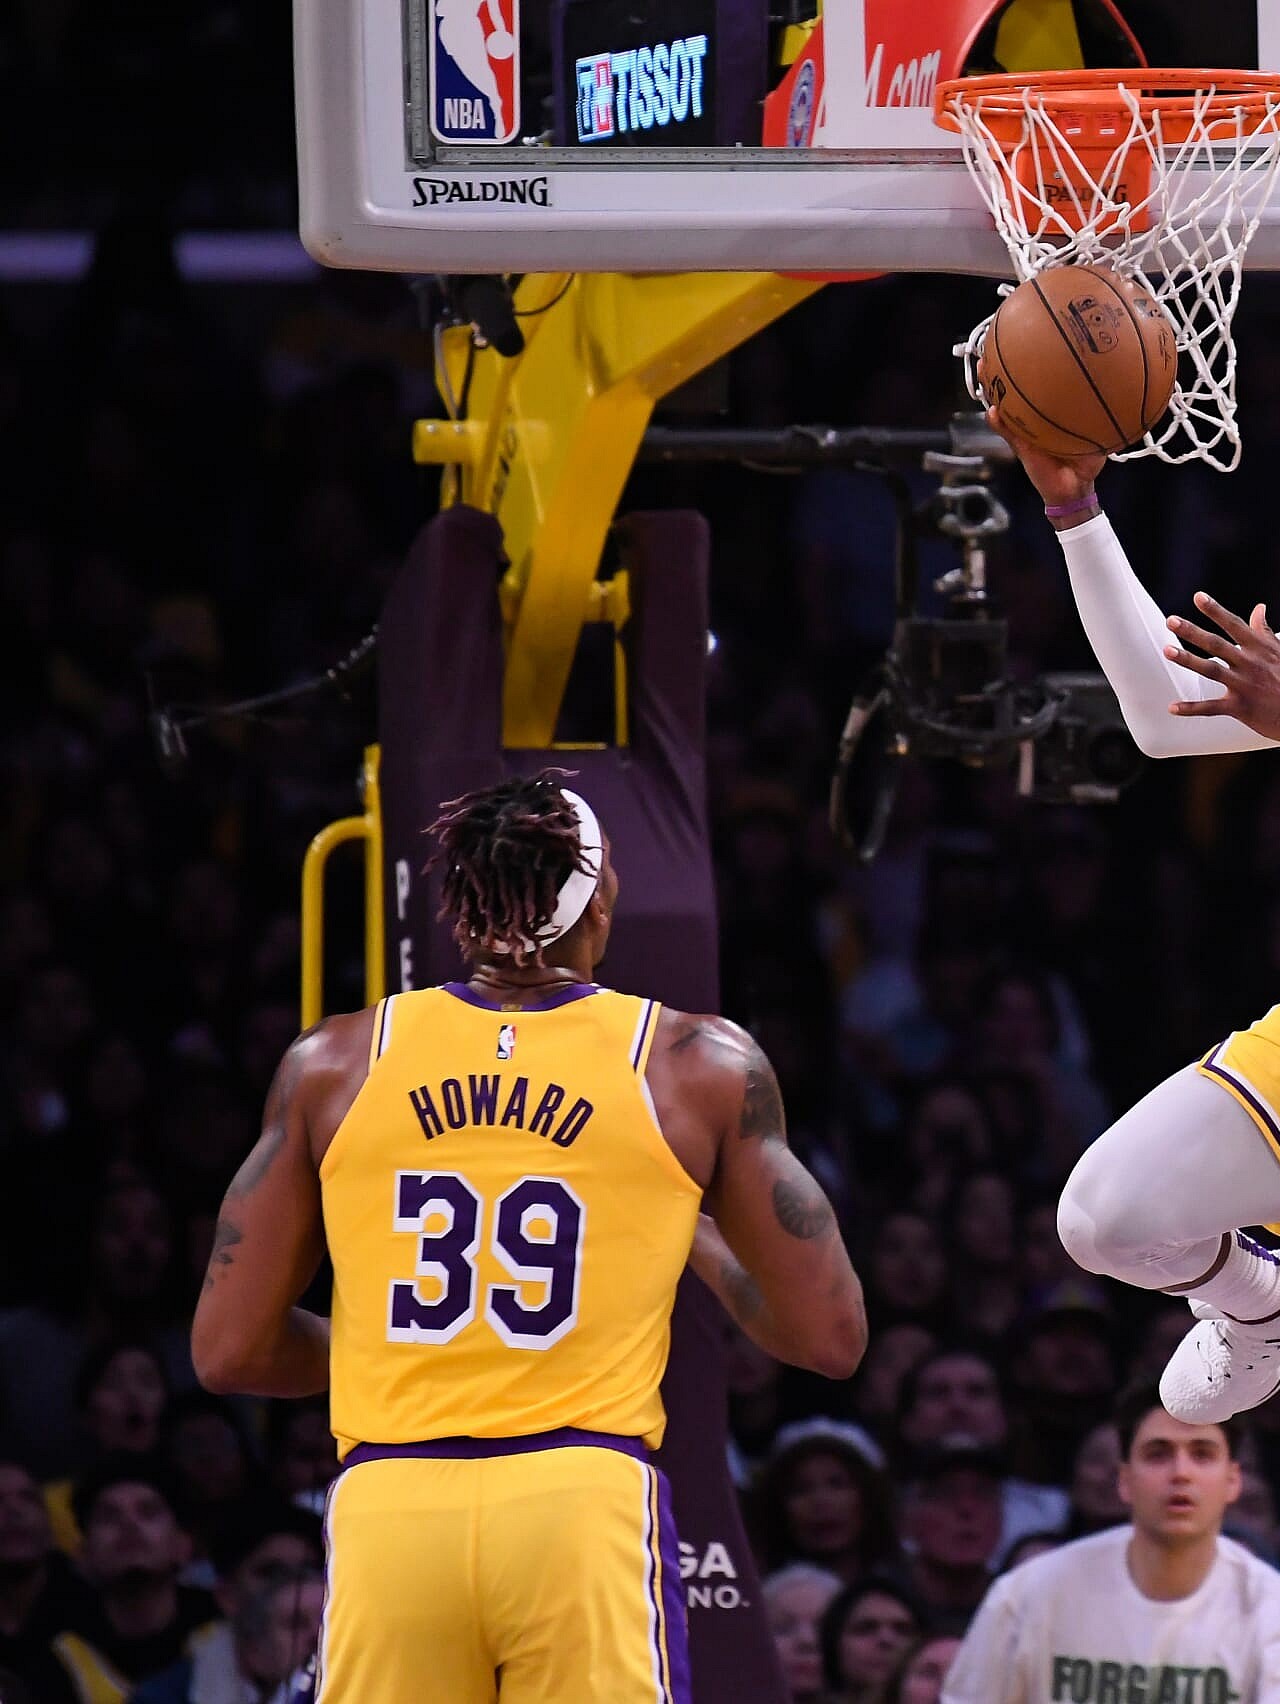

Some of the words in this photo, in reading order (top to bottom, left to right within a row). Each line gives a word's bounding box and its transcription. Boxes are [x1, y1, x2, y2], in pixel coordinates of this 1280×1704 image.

[443, 97, 486, 130] NBA
[611, 34, 707, 133] TISSOT
[412, 176, 549, 208] SPALDING
[408, 1074, 595, 1149] HOWARD
[387, 1168, 587, 1351] 39
